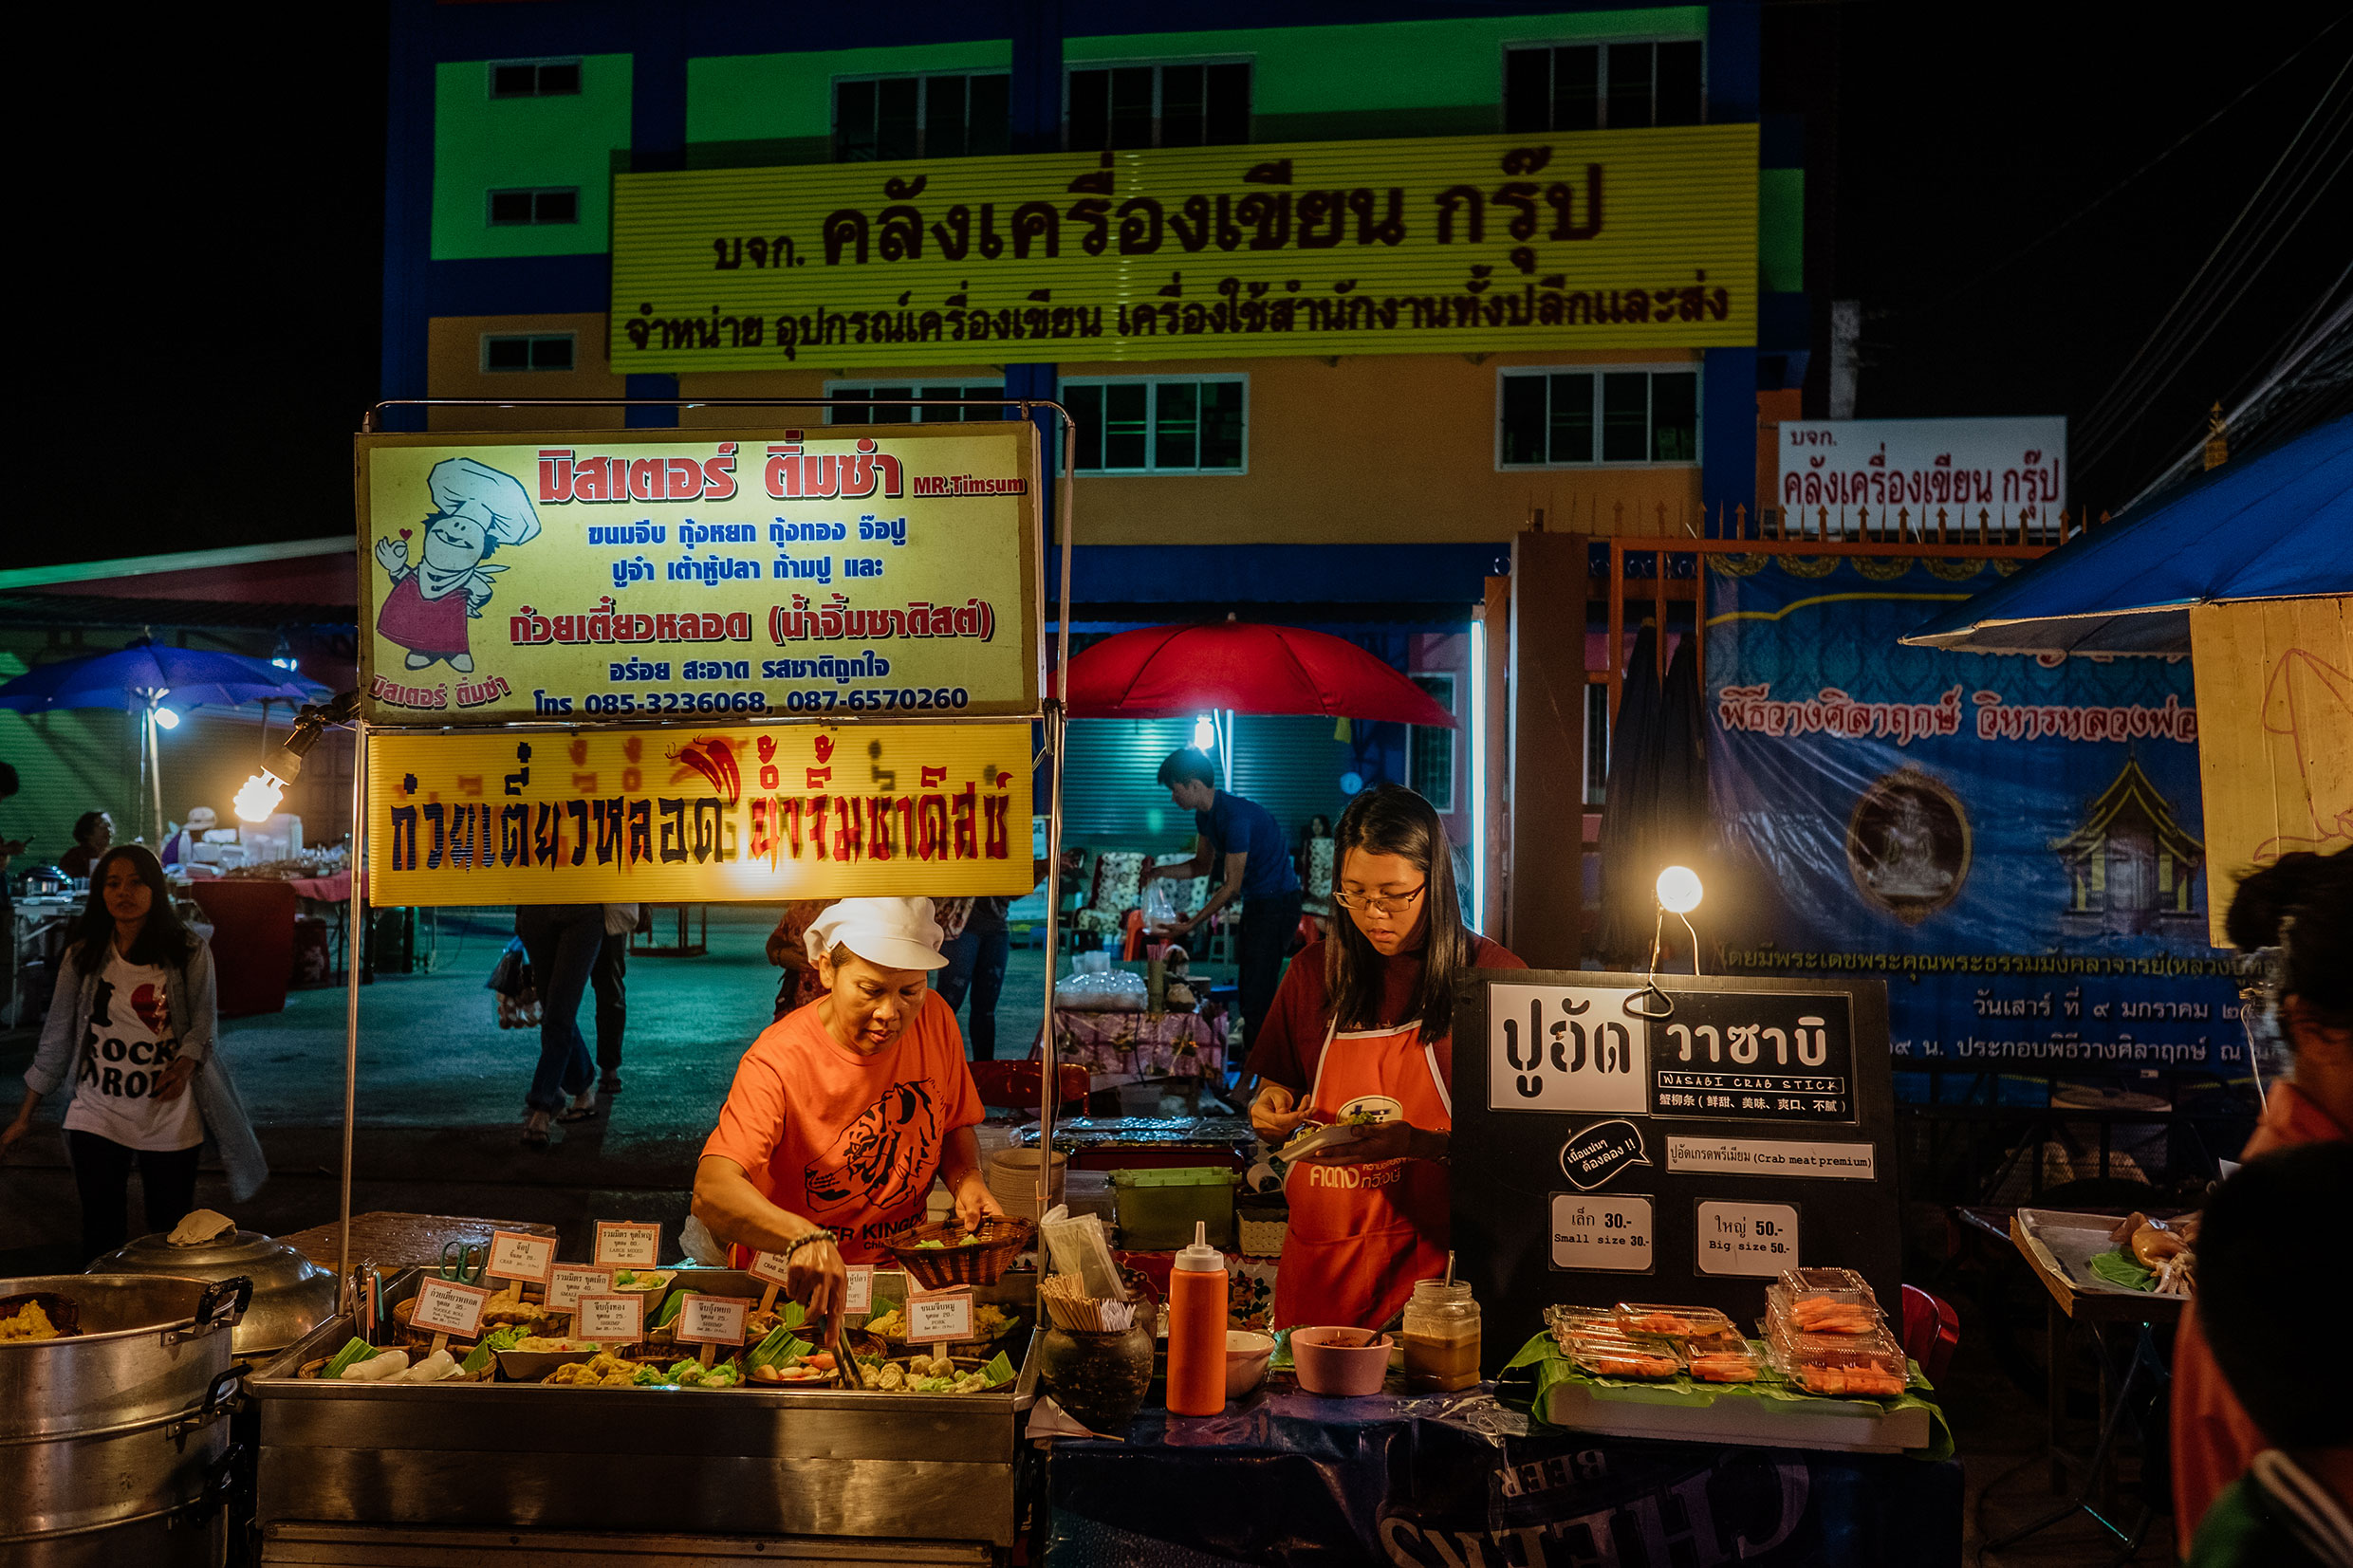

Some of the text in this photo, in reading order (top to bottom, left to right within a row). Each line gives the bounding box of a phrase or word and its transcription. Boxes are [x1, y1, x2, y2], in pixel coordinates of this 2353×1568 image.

[713, 146, 1604, 274] บจก. คลังเครื่องเขียน กรุ๊ป
[625, 302, 764, 351] จำหน่าย
[775, 280, 1102, 361] อุปกรณ์เครื่องเขียน
[1790, 430, 1838, 446] บจก.
[537, 441, 738, 505] มิสเตอร์
[913, 474, 1028, 497] MR.Timsum
[1785, 442, 2060, 520] คลังเครื่องเขียน กรุ๊ป
[588, 519, 666, 545] ขนมจีบ
[678, 518, 757, 550] กุ้งหยก
[769, 517, 846, 547] กุ้งทอง
[668, 554, 760, 586] เต้าหู้ปลา
[773, 554, 831, 583] ก้ามปู
[844, 558, 883, 577] และ
[510, 596, 752, 644] ก๋วยเตี๋ยวหลอด
[610, 651, 890, 683] อร่อย สะอาด รสชาติถูกใจ
[533, 690, 572, 716] โทร
[787, 688, 968, 710] 087-6570260
[1973, 987, 2051, 1019] วันเสาร์
[2121, 1001, 2208, 1020] มกราคม
[1503, 997, 1826, 1098] ปูอัด วาซาบิ
[1663, 1074, 1839, 1092] WASABI CRAB STICK
[1582, 1145, 1624, 1172] ต้องลอง
[1788, 1156, 1817, 1165] meat
[1819, 1157, 1872, 1169] premium)
[1571, 1207, 1632, 1228] เล็ก 30.-
[1714, 1214, 1784, 1238] ใหญ่ 50.-
[1554, 1234, 1650, 1247] Small size 30.-
[1709, 1241, 1790, 1254] Big size 50.-
[1494, 1448, 1608, 1498] BEER
